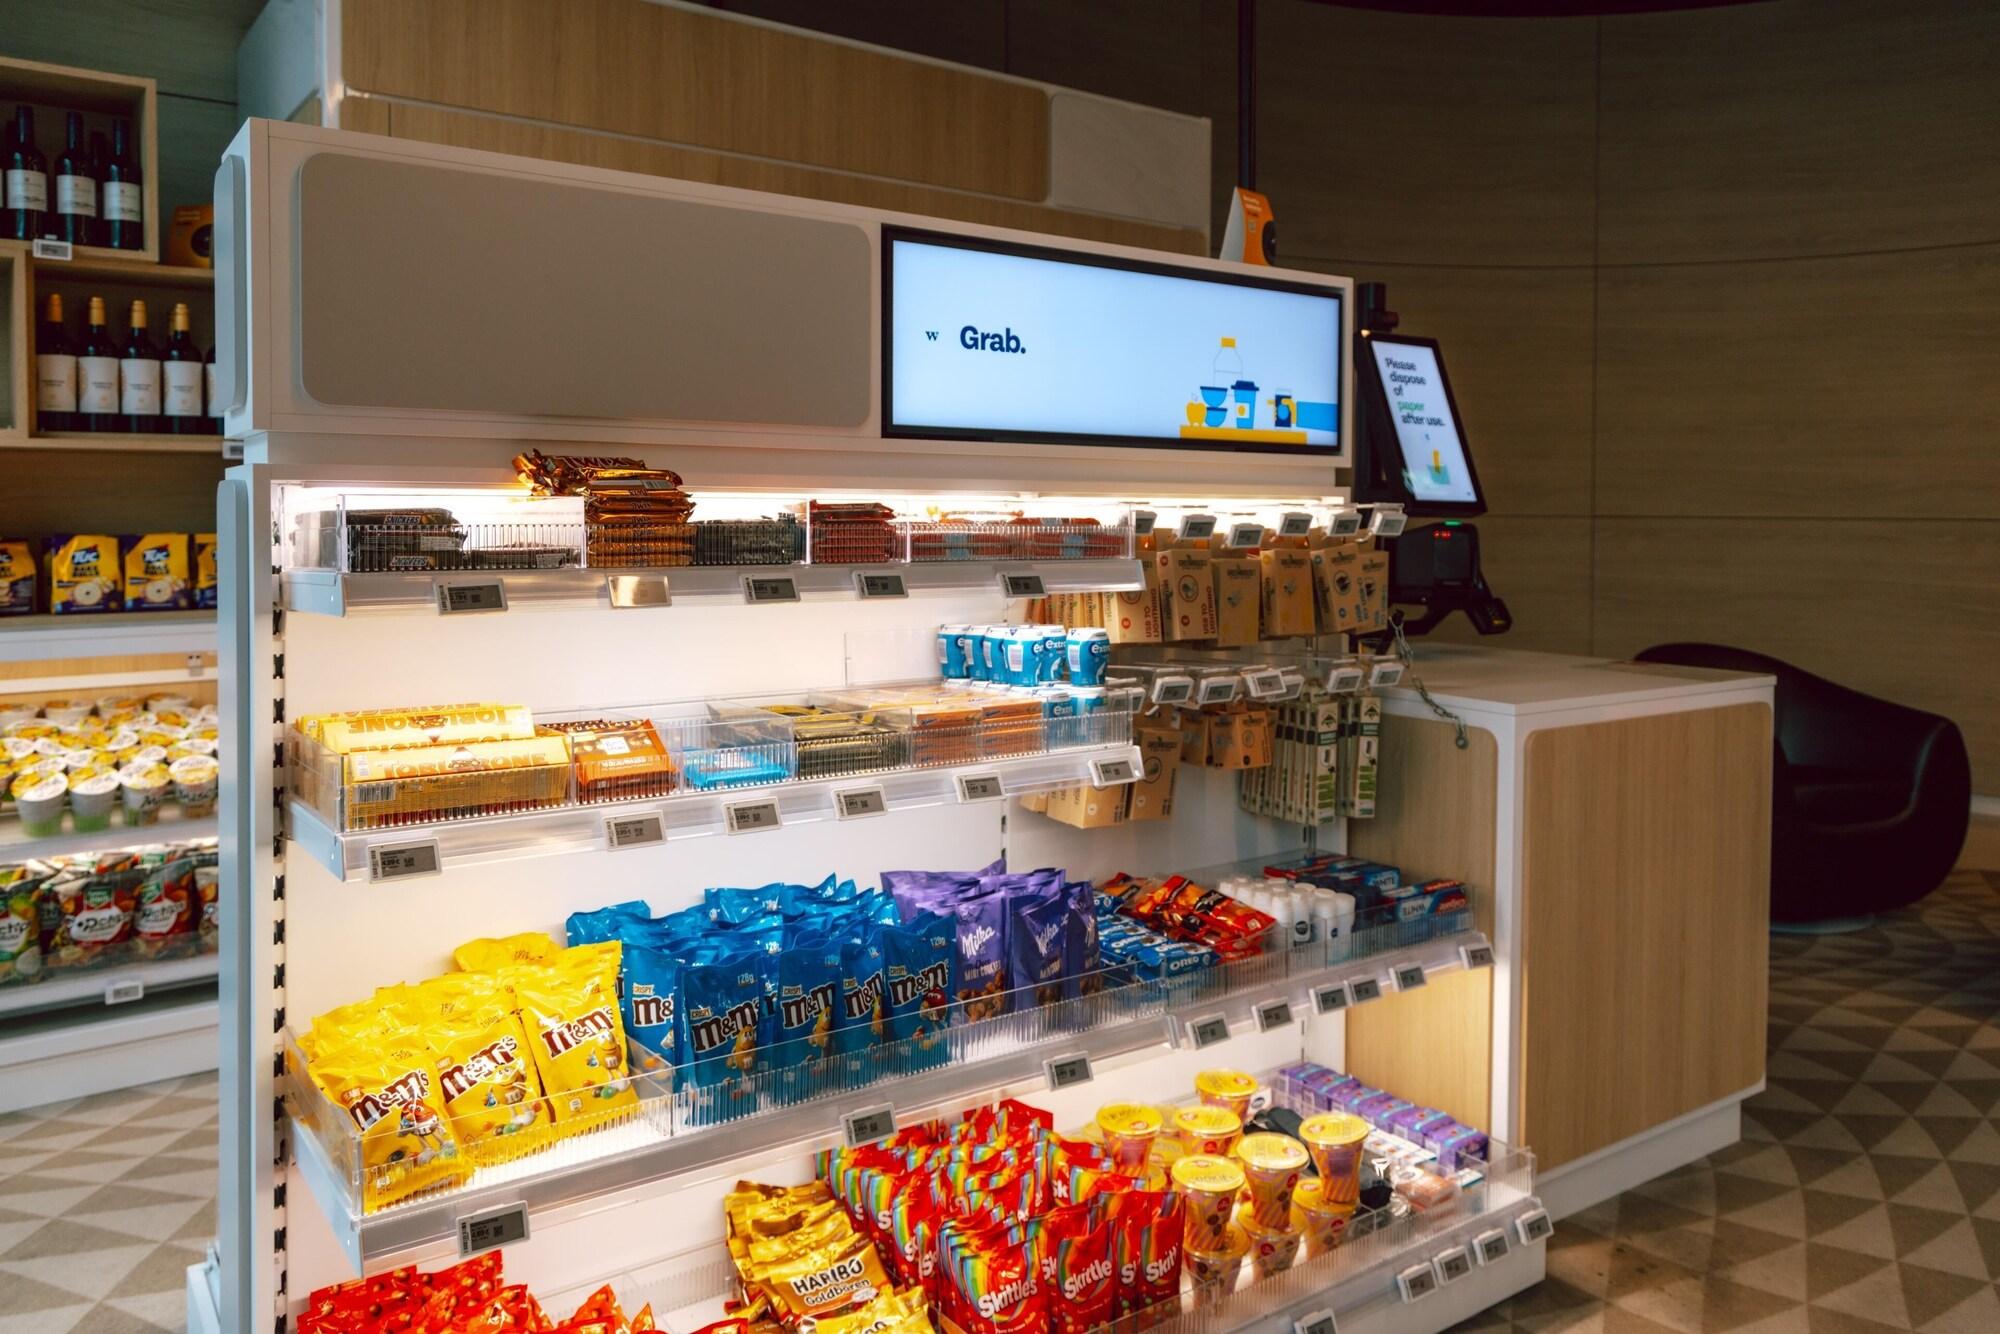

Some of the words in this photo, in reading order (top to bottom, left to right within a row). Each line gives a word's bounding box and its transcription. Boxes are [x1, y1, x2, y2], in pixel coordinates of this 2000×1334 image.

[960, 325, 1026, 354] Grab.
[1384, 358, 1417, 371] Please
[1389, 371, 1426, 386] dispose
[1393, 385, 1404, 397] of
[1398, 401, 1425, 413] paper
[1401, 412, 1425, 425] after
[1427, 416, 1446, 427] use.
[385, 514, 421, 525] SNICKERS
[961, 926, 995, 959] Milka
[1169, 955, 1200, 971] OREO
[793, 1256, 864, 1295] HARIBO
[1063, 1259, 1113, 1300] Skittle
[977, 1278, 1038, 1319] Skittles
